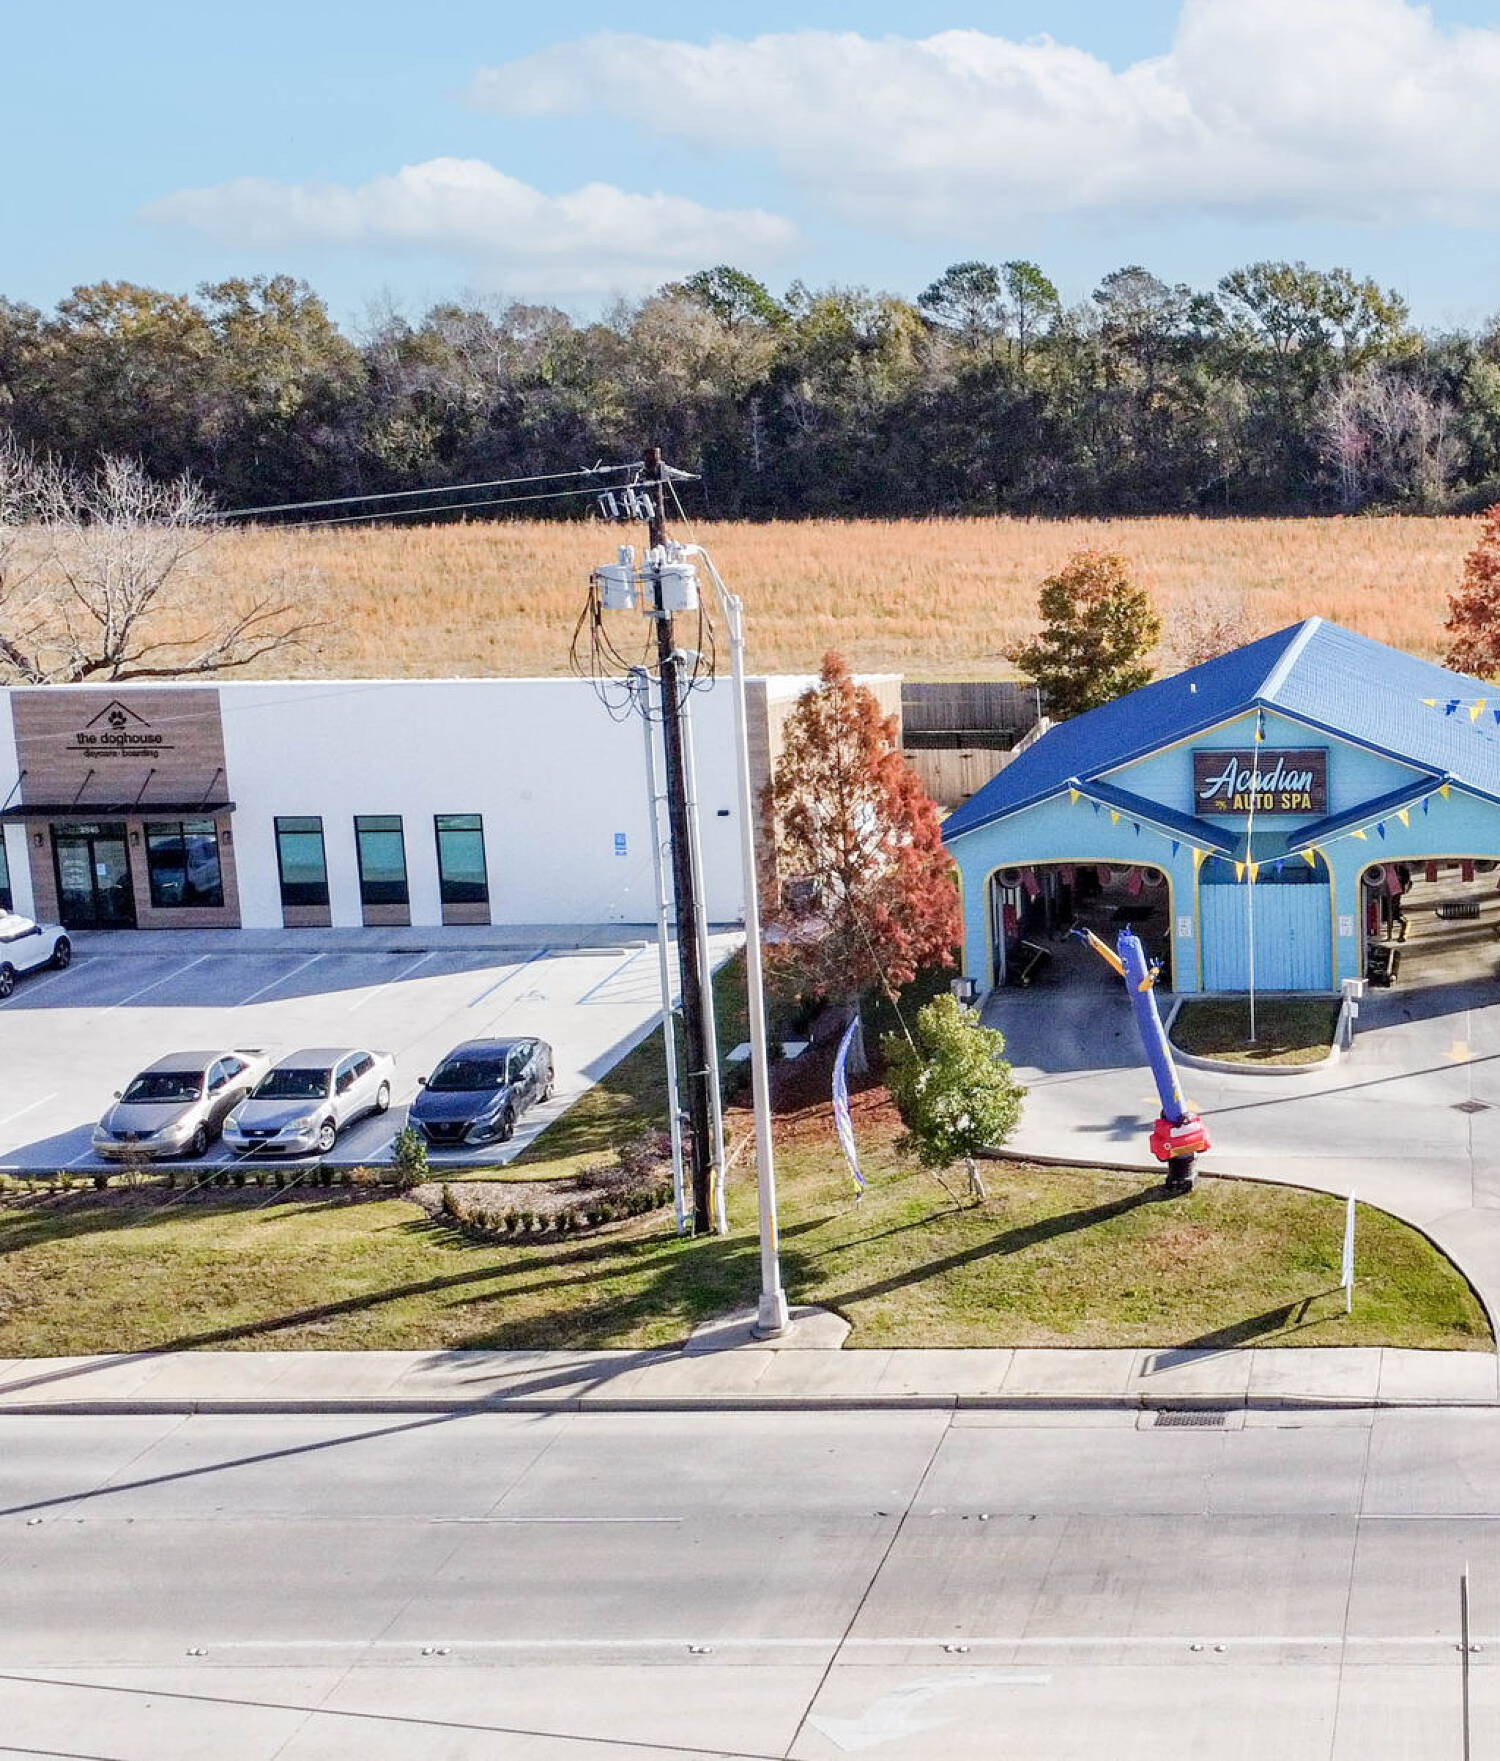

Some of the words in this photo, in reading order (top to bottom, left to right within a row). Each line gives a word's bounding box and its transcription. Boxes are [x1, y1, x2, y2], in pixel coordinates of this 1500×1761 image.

[76, 732, 97, 744] the
[100, 732, 162, 745] doghouse
[1199, 756, 1313, 798] Acadian
[1280, 793, 1312, 809] SPA
